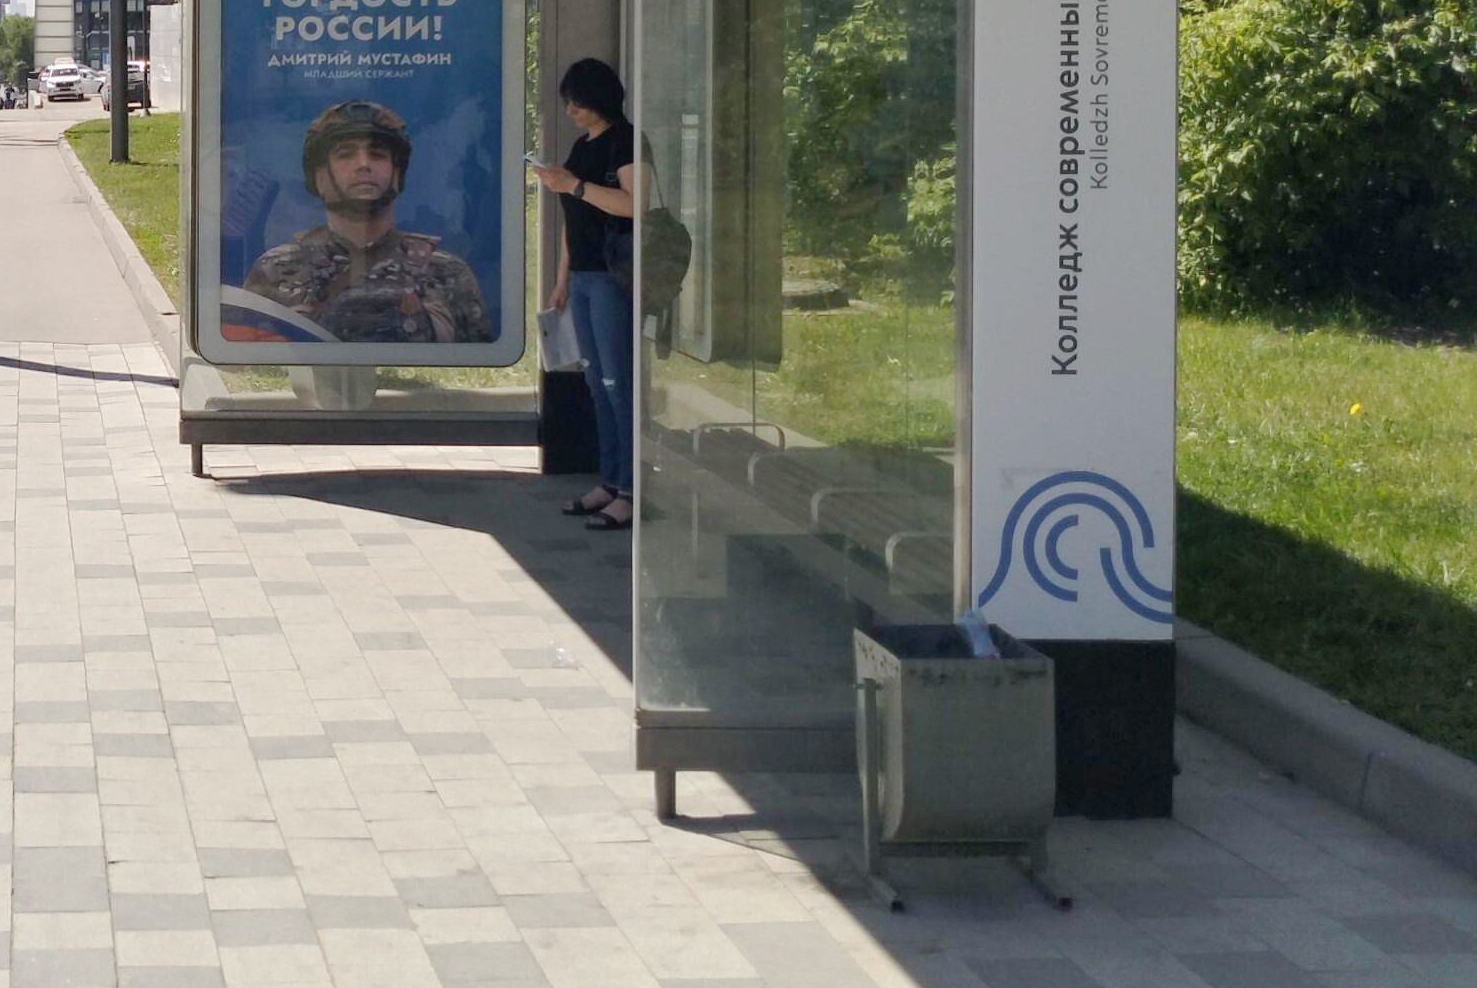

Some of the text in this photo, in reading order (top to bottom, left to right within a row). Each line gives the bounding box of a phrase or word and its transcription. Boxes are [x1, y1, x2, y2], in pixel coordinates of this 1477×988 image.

[275, 15, 443, 42] РОССИИ!
[267, 49, 453, 68] ДМИТРИЙ МУСТАФИН
[303, 68, 416, 79] МЛАДШИЙ СЕРЖАНТ
[1089, 92, 1109, 190] Kolledzh
[1050, 222, 1083, 376] Колледж
